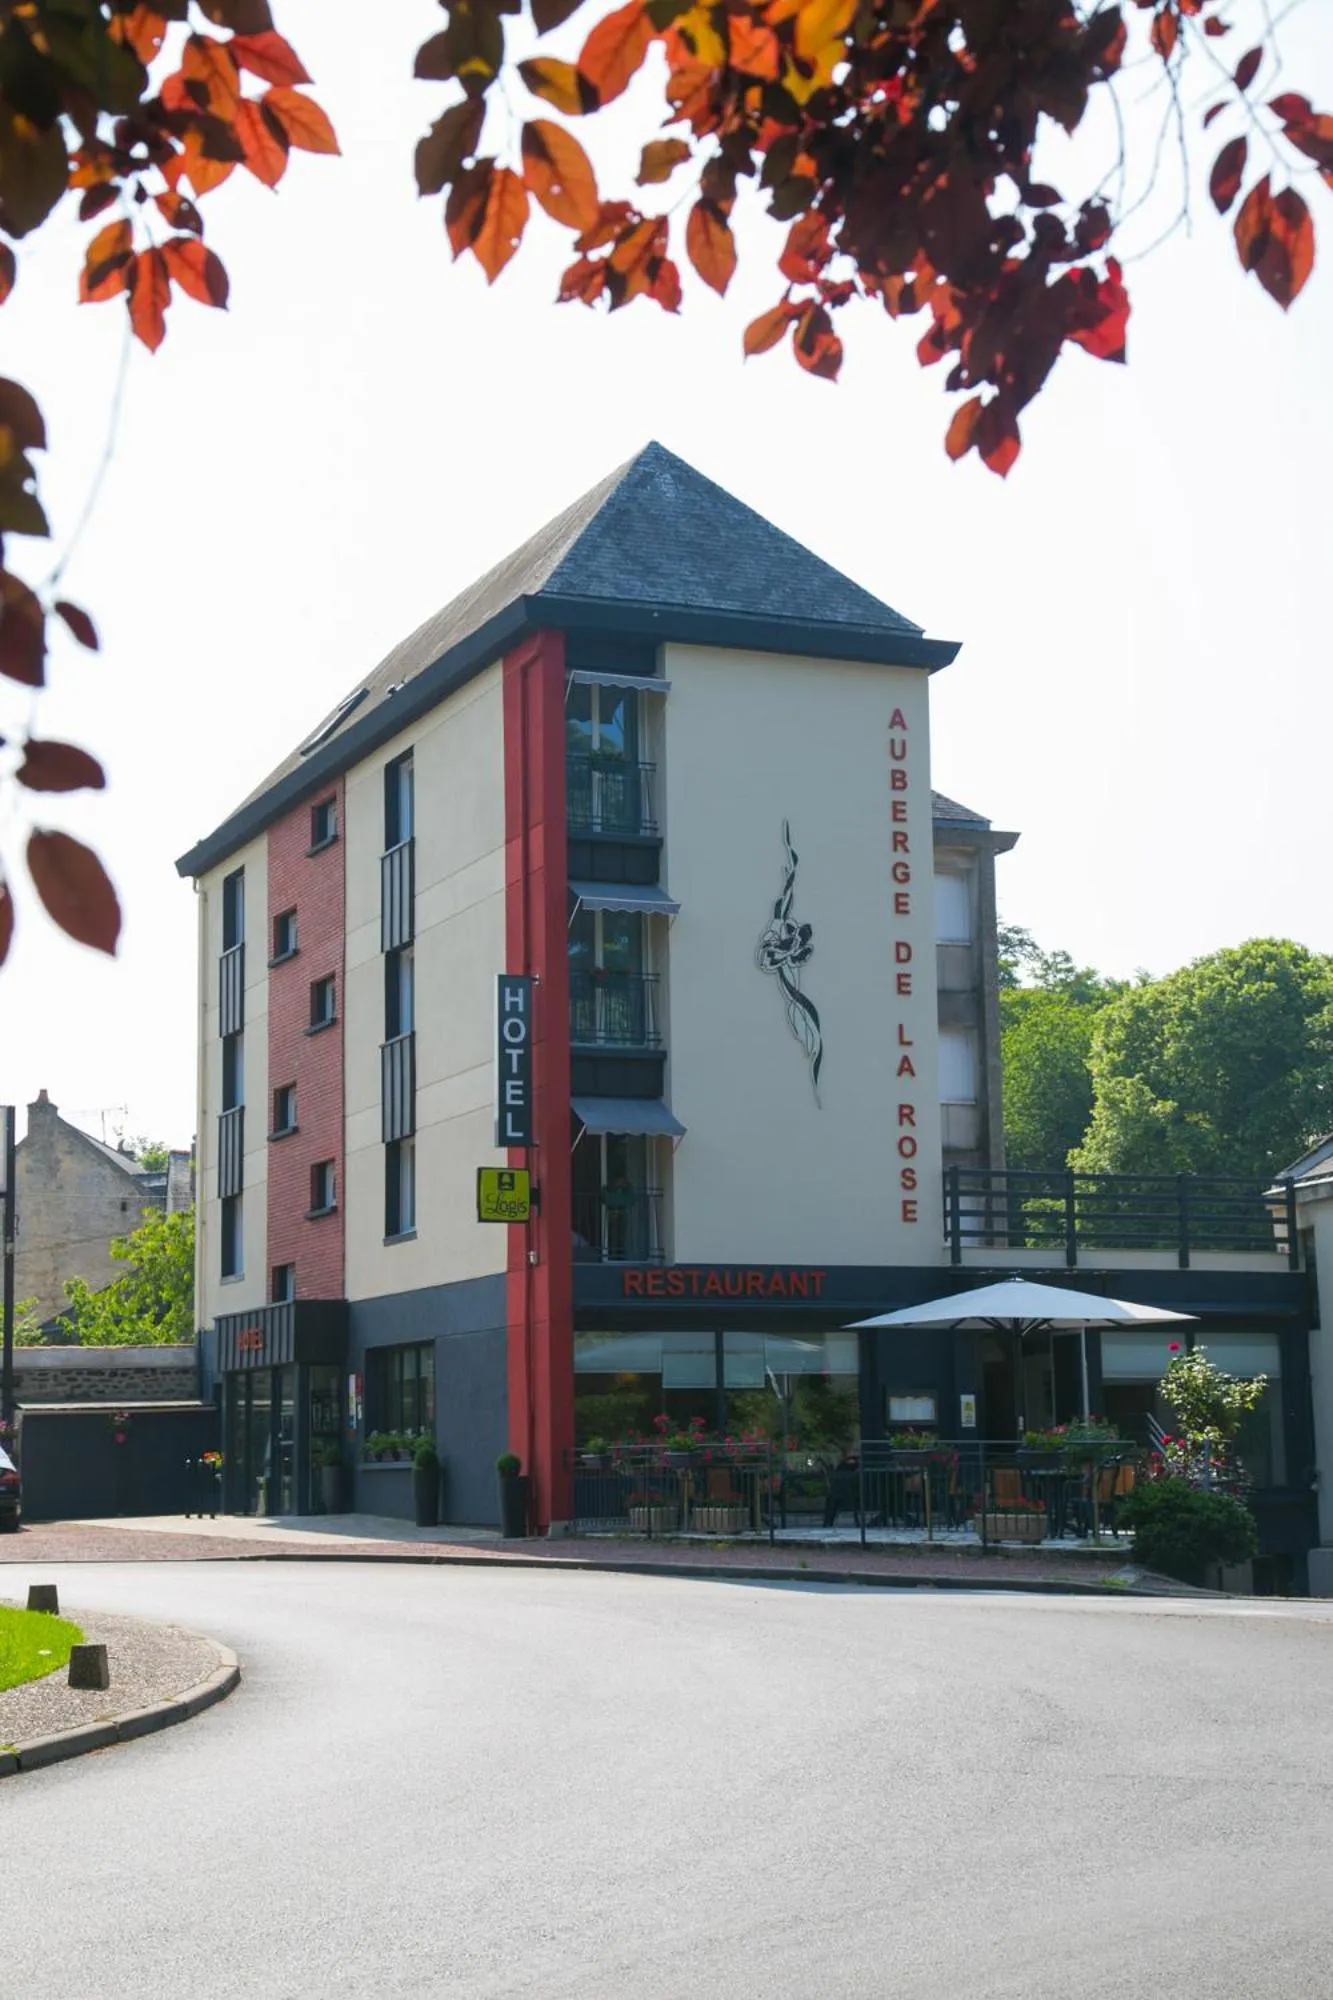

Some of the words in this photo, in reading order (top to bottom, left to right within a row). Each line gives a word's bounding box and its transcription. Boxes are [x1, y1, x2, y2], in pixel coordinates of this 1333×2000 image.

[888, 707, 911, 915] AUBERGE
[895, 941, 912, 995] DE
[503, 987, 526, 1137] HOTEL
[896, 1023, 916, 1078] LA
[897, 1103, 918, 1223] ROSE
[485, 1192, 528, 1218] Logis
[622, 1269, 828, 1297] RESTAURANT
